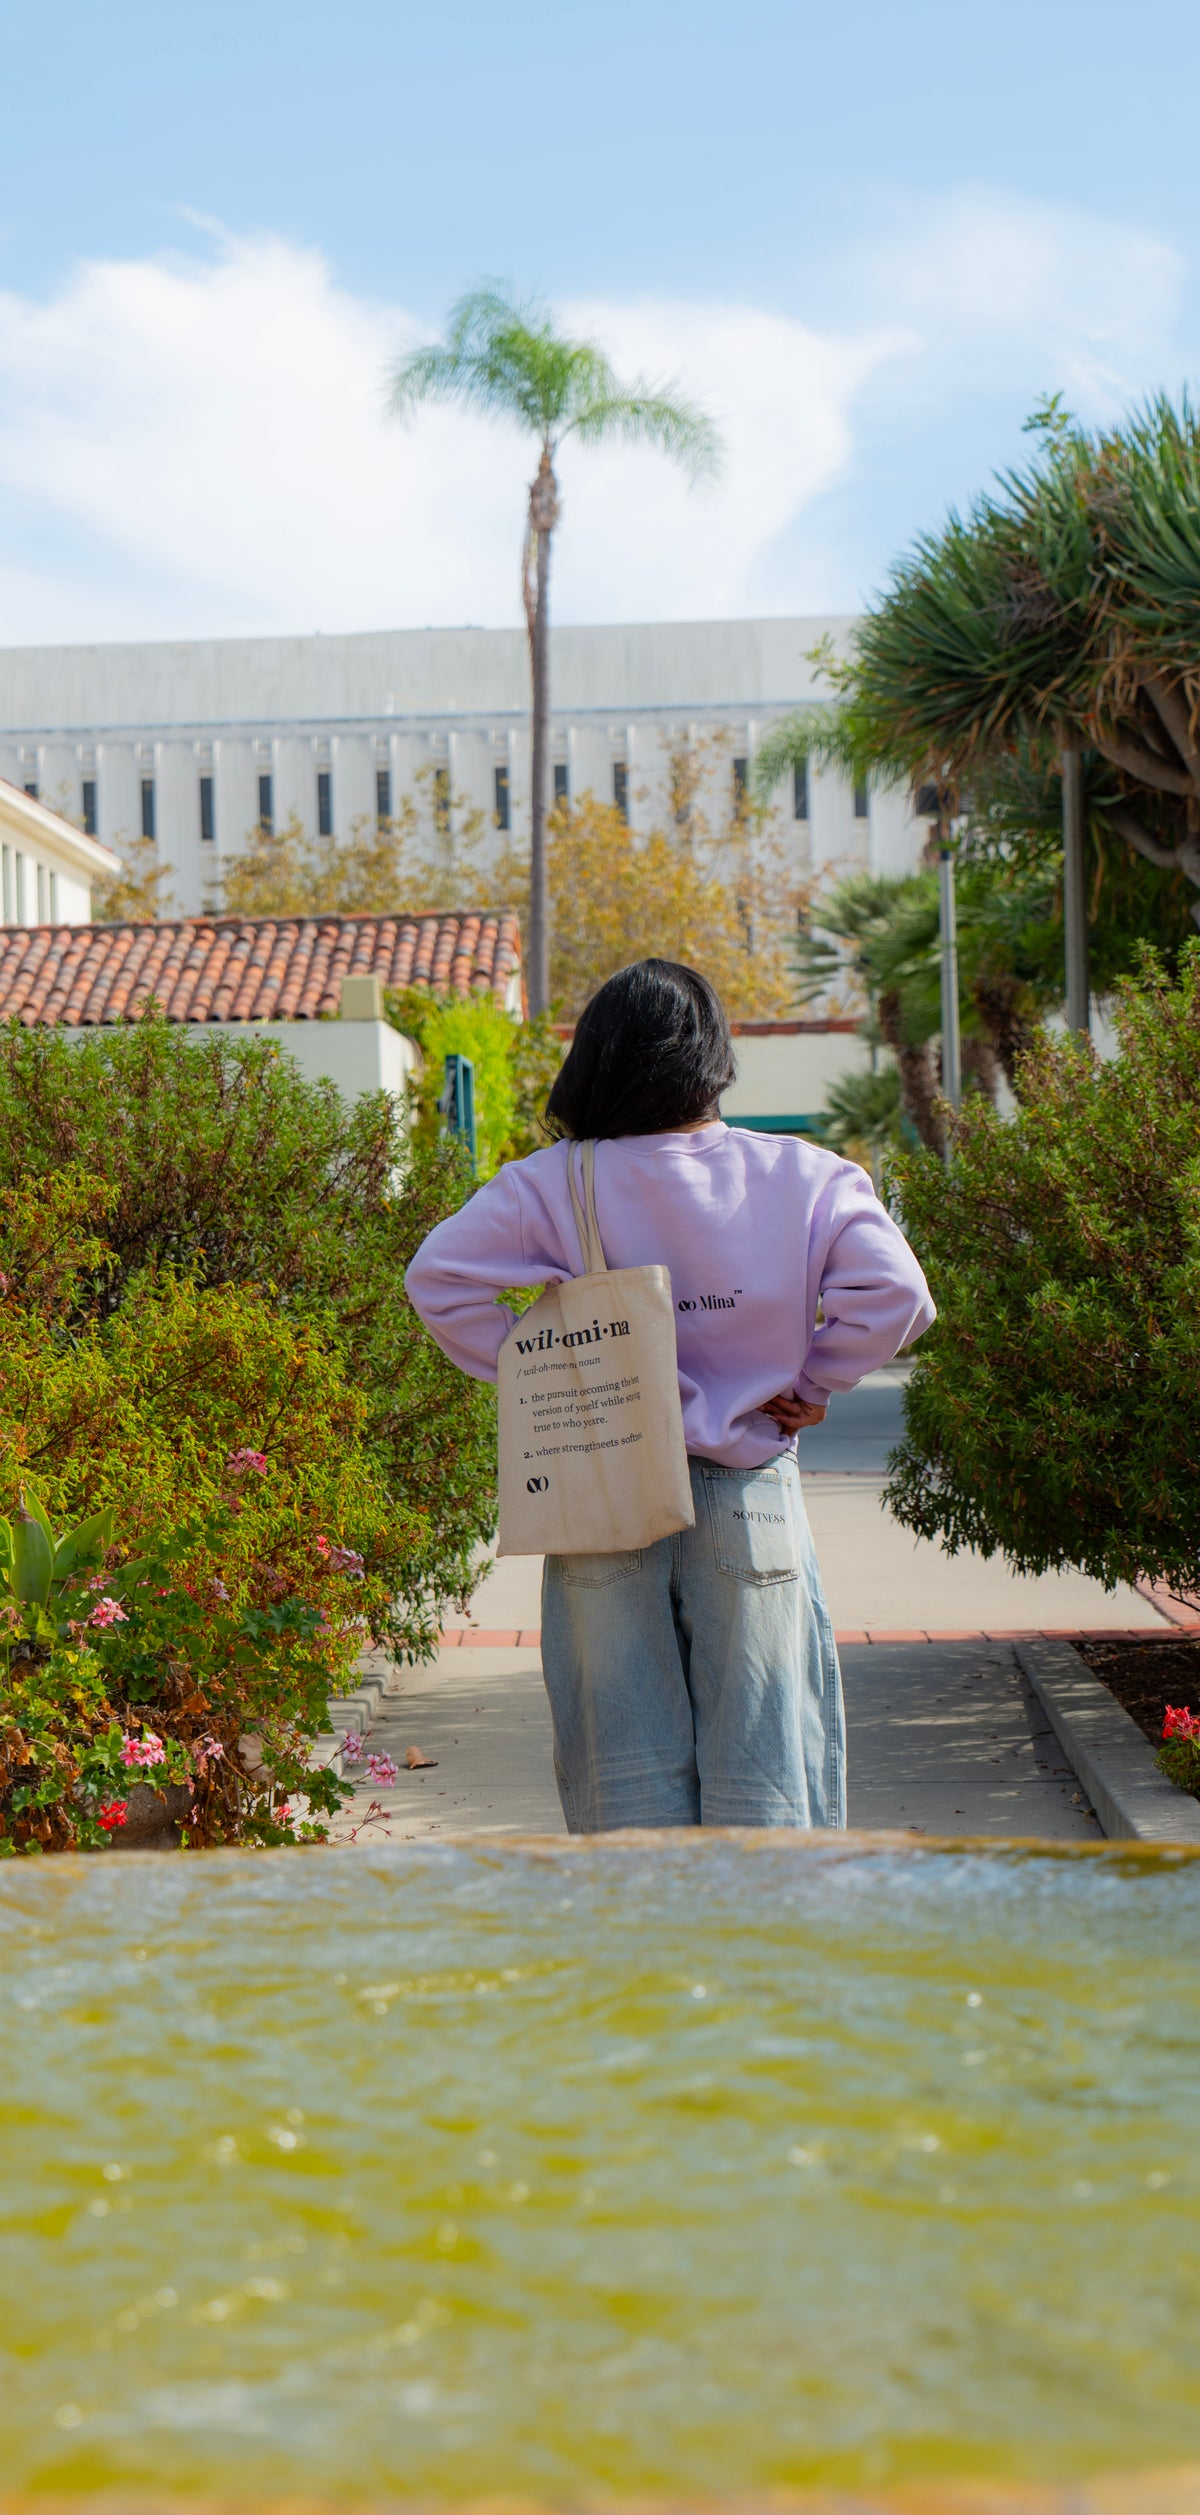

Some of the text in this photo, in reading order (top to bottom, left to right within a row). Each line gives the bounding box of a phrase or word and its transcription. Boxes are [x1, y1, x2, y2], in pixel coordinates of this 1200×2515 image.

[579, 1356, 601, 1367] noun
[519, 1397, 528, 1405] 1.
[531, 1392, 546, 1403] the
[546, 1388, 578, 1402] pursuit
[532, 1404, 563, 1418] version
[564, 1402, 575, 1413] of
[600, 1395, 625, 1408] while
[533, 1422, 552, 1433] true
[552, 1420, 561, 1430] to
[561, 1417, 582, 1428] who
[523, 1451, 534, 1459] 2.
[535, 1446, 561, 1456] where
